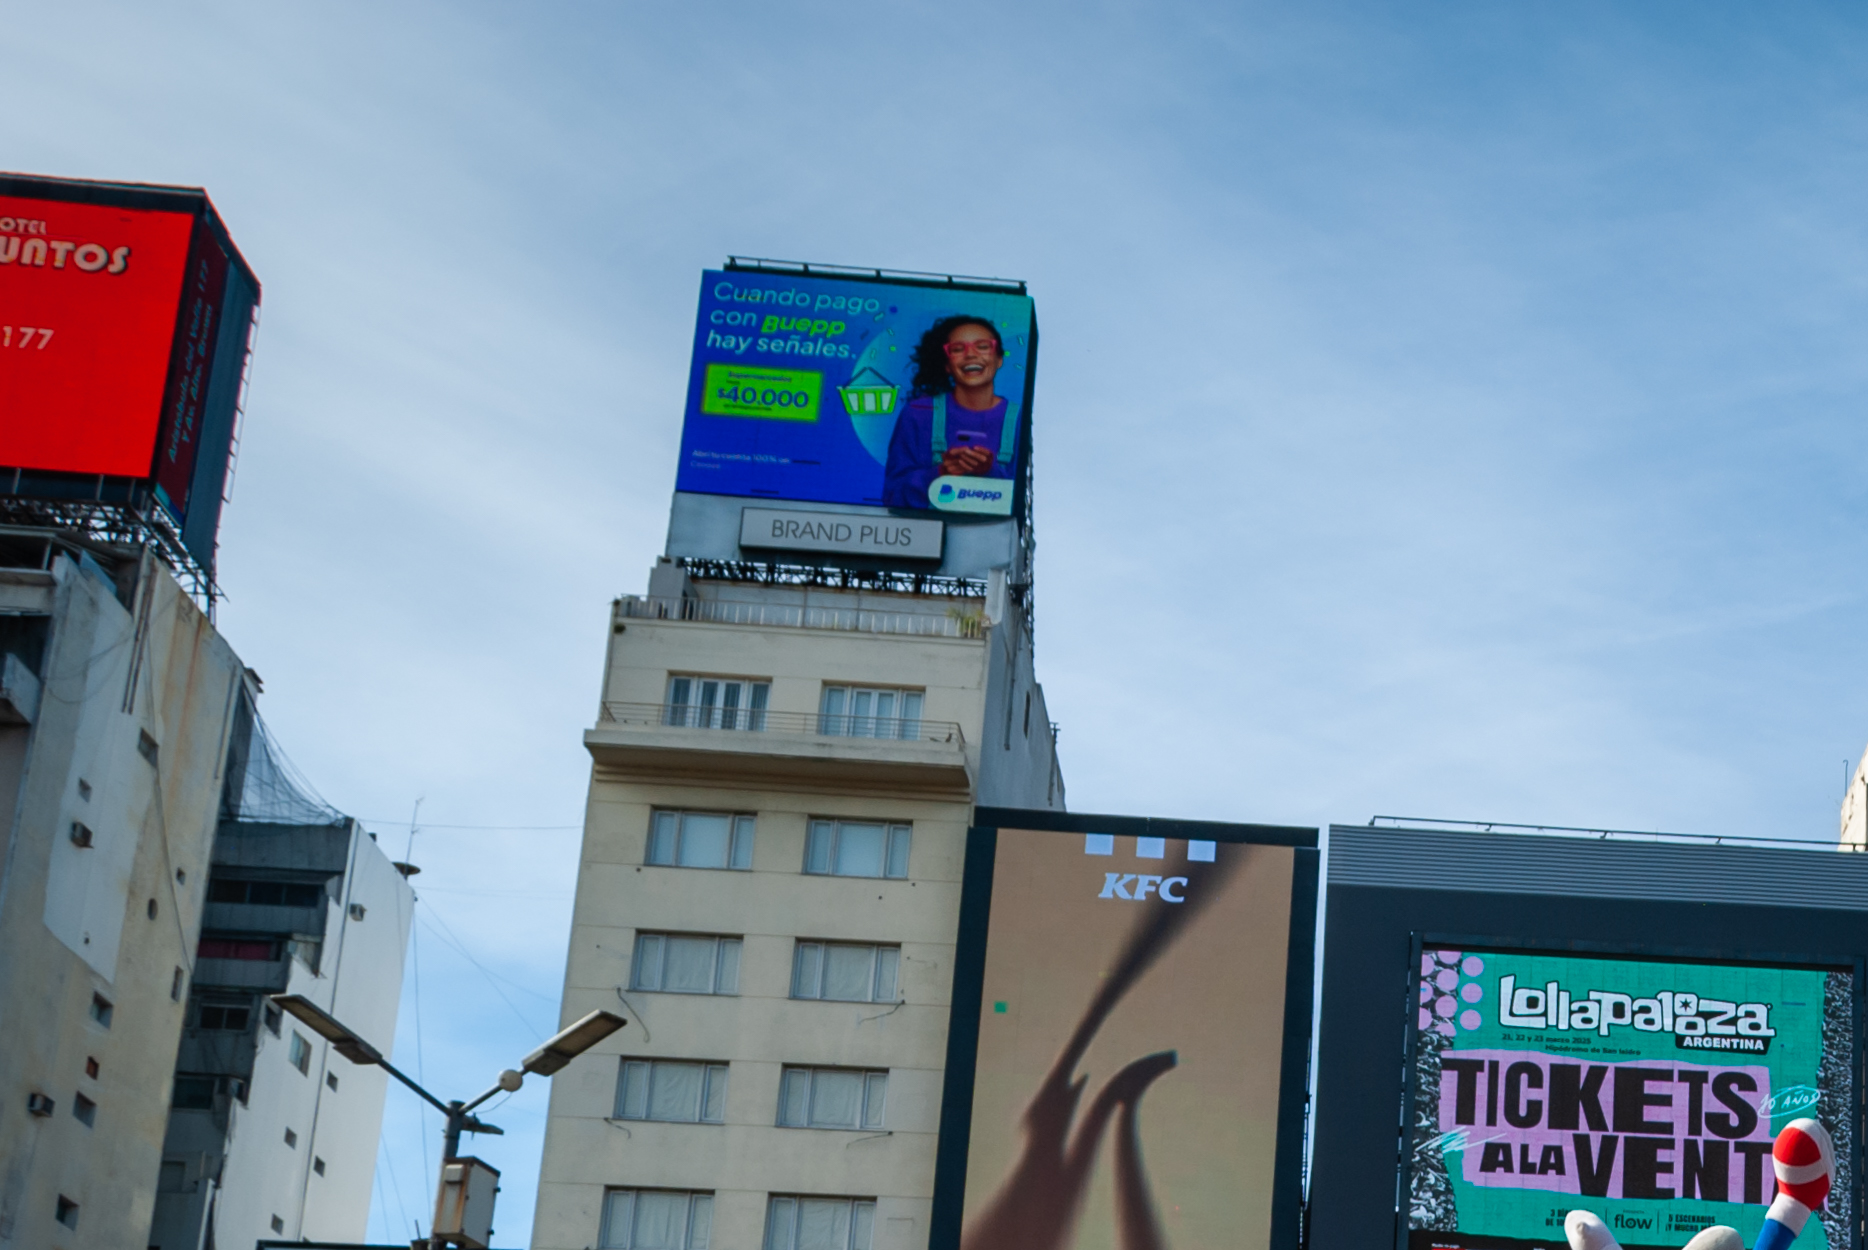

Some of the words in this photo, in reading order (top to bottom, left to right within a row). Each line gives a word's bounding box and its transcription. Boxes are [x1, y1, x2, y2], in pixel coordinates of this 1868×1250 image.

[714, 281, 813, 308] Cuando
[2, 325, 55, 350] 177
[710, 309, 757, 327] con
[761, 314, 846, 338] Buepp
[706, 330, 754, 355] hay
[756, 334, 857, 360] señales.
[957, 487, 1002, 502] Buepp
[771, 518, 851, 543] BRAND
[859, 525, 912, 547] PLUS
[1098, 872, 1188, 903] KFC
[1682, 1035, 1765, 1052] ARGENTINA
[1441, 1058, 1759, 1139] TICKETS
[1479, 1142, 1514, 1173] A
[1519, 1144, 1566, 1176] LA
[1573, 1133, 1773, 1206] VENT
[1614, 1214, 1653, 1230] flow
